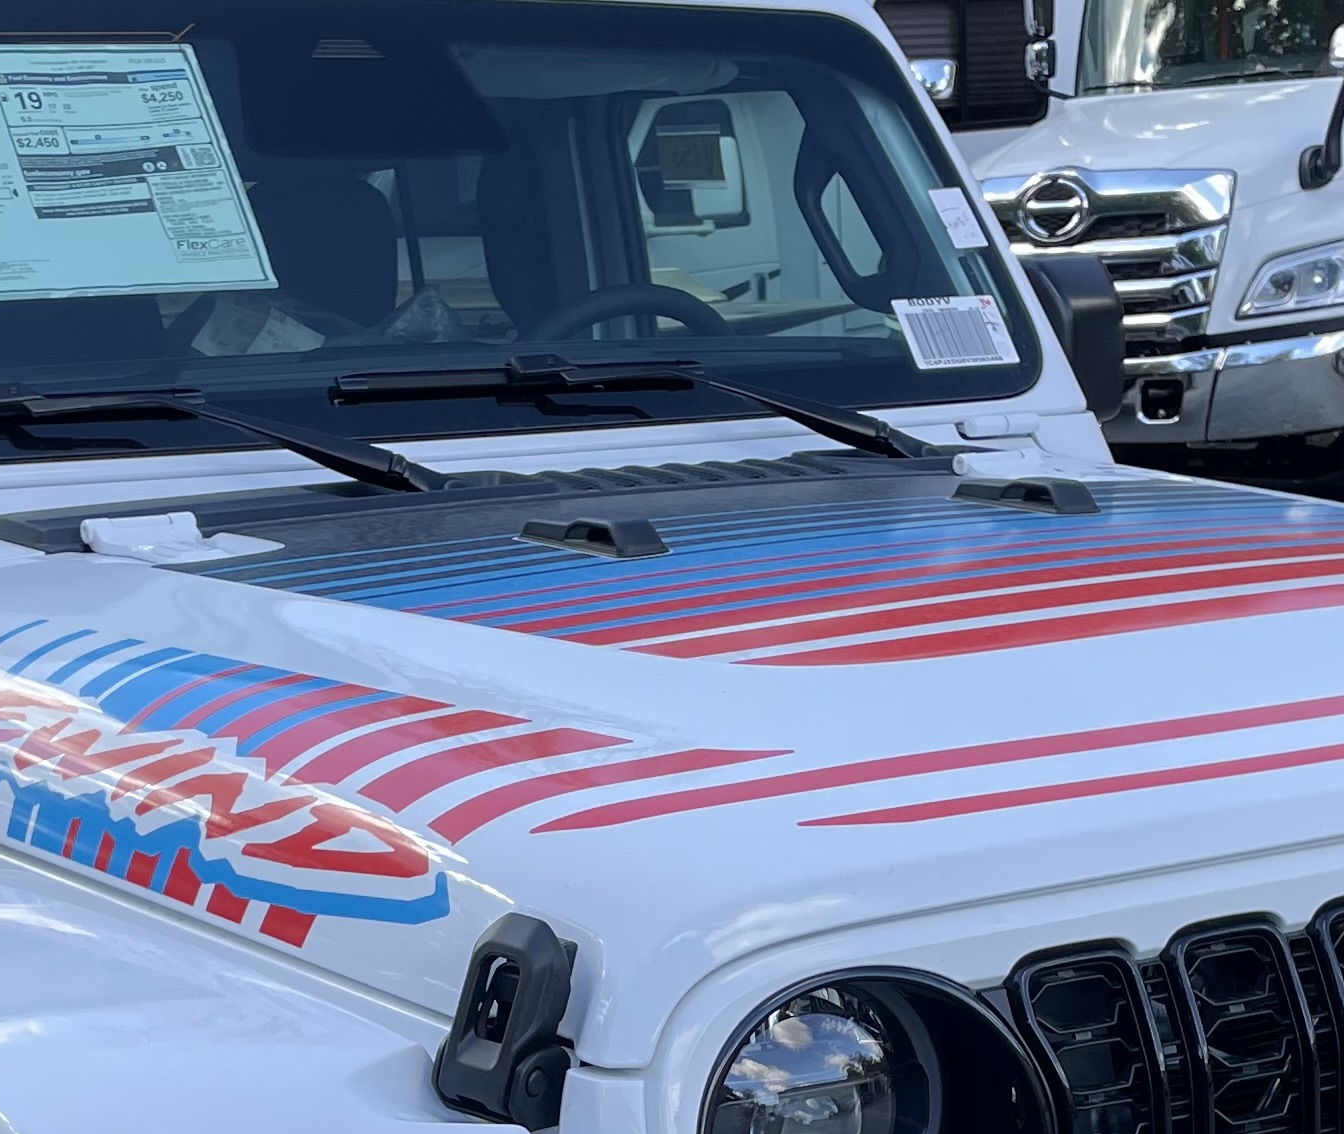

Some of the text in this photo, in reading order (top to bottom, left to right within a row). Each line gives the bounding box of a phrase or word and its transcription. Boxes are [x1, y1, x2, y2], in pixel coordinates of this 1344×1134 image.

[14, 91, 43, 110] 19
[141, 91, 183, 104] $4,250
[16, 137, 60, 149] $2,450
[176, 238, 246, 250] FlexCare
